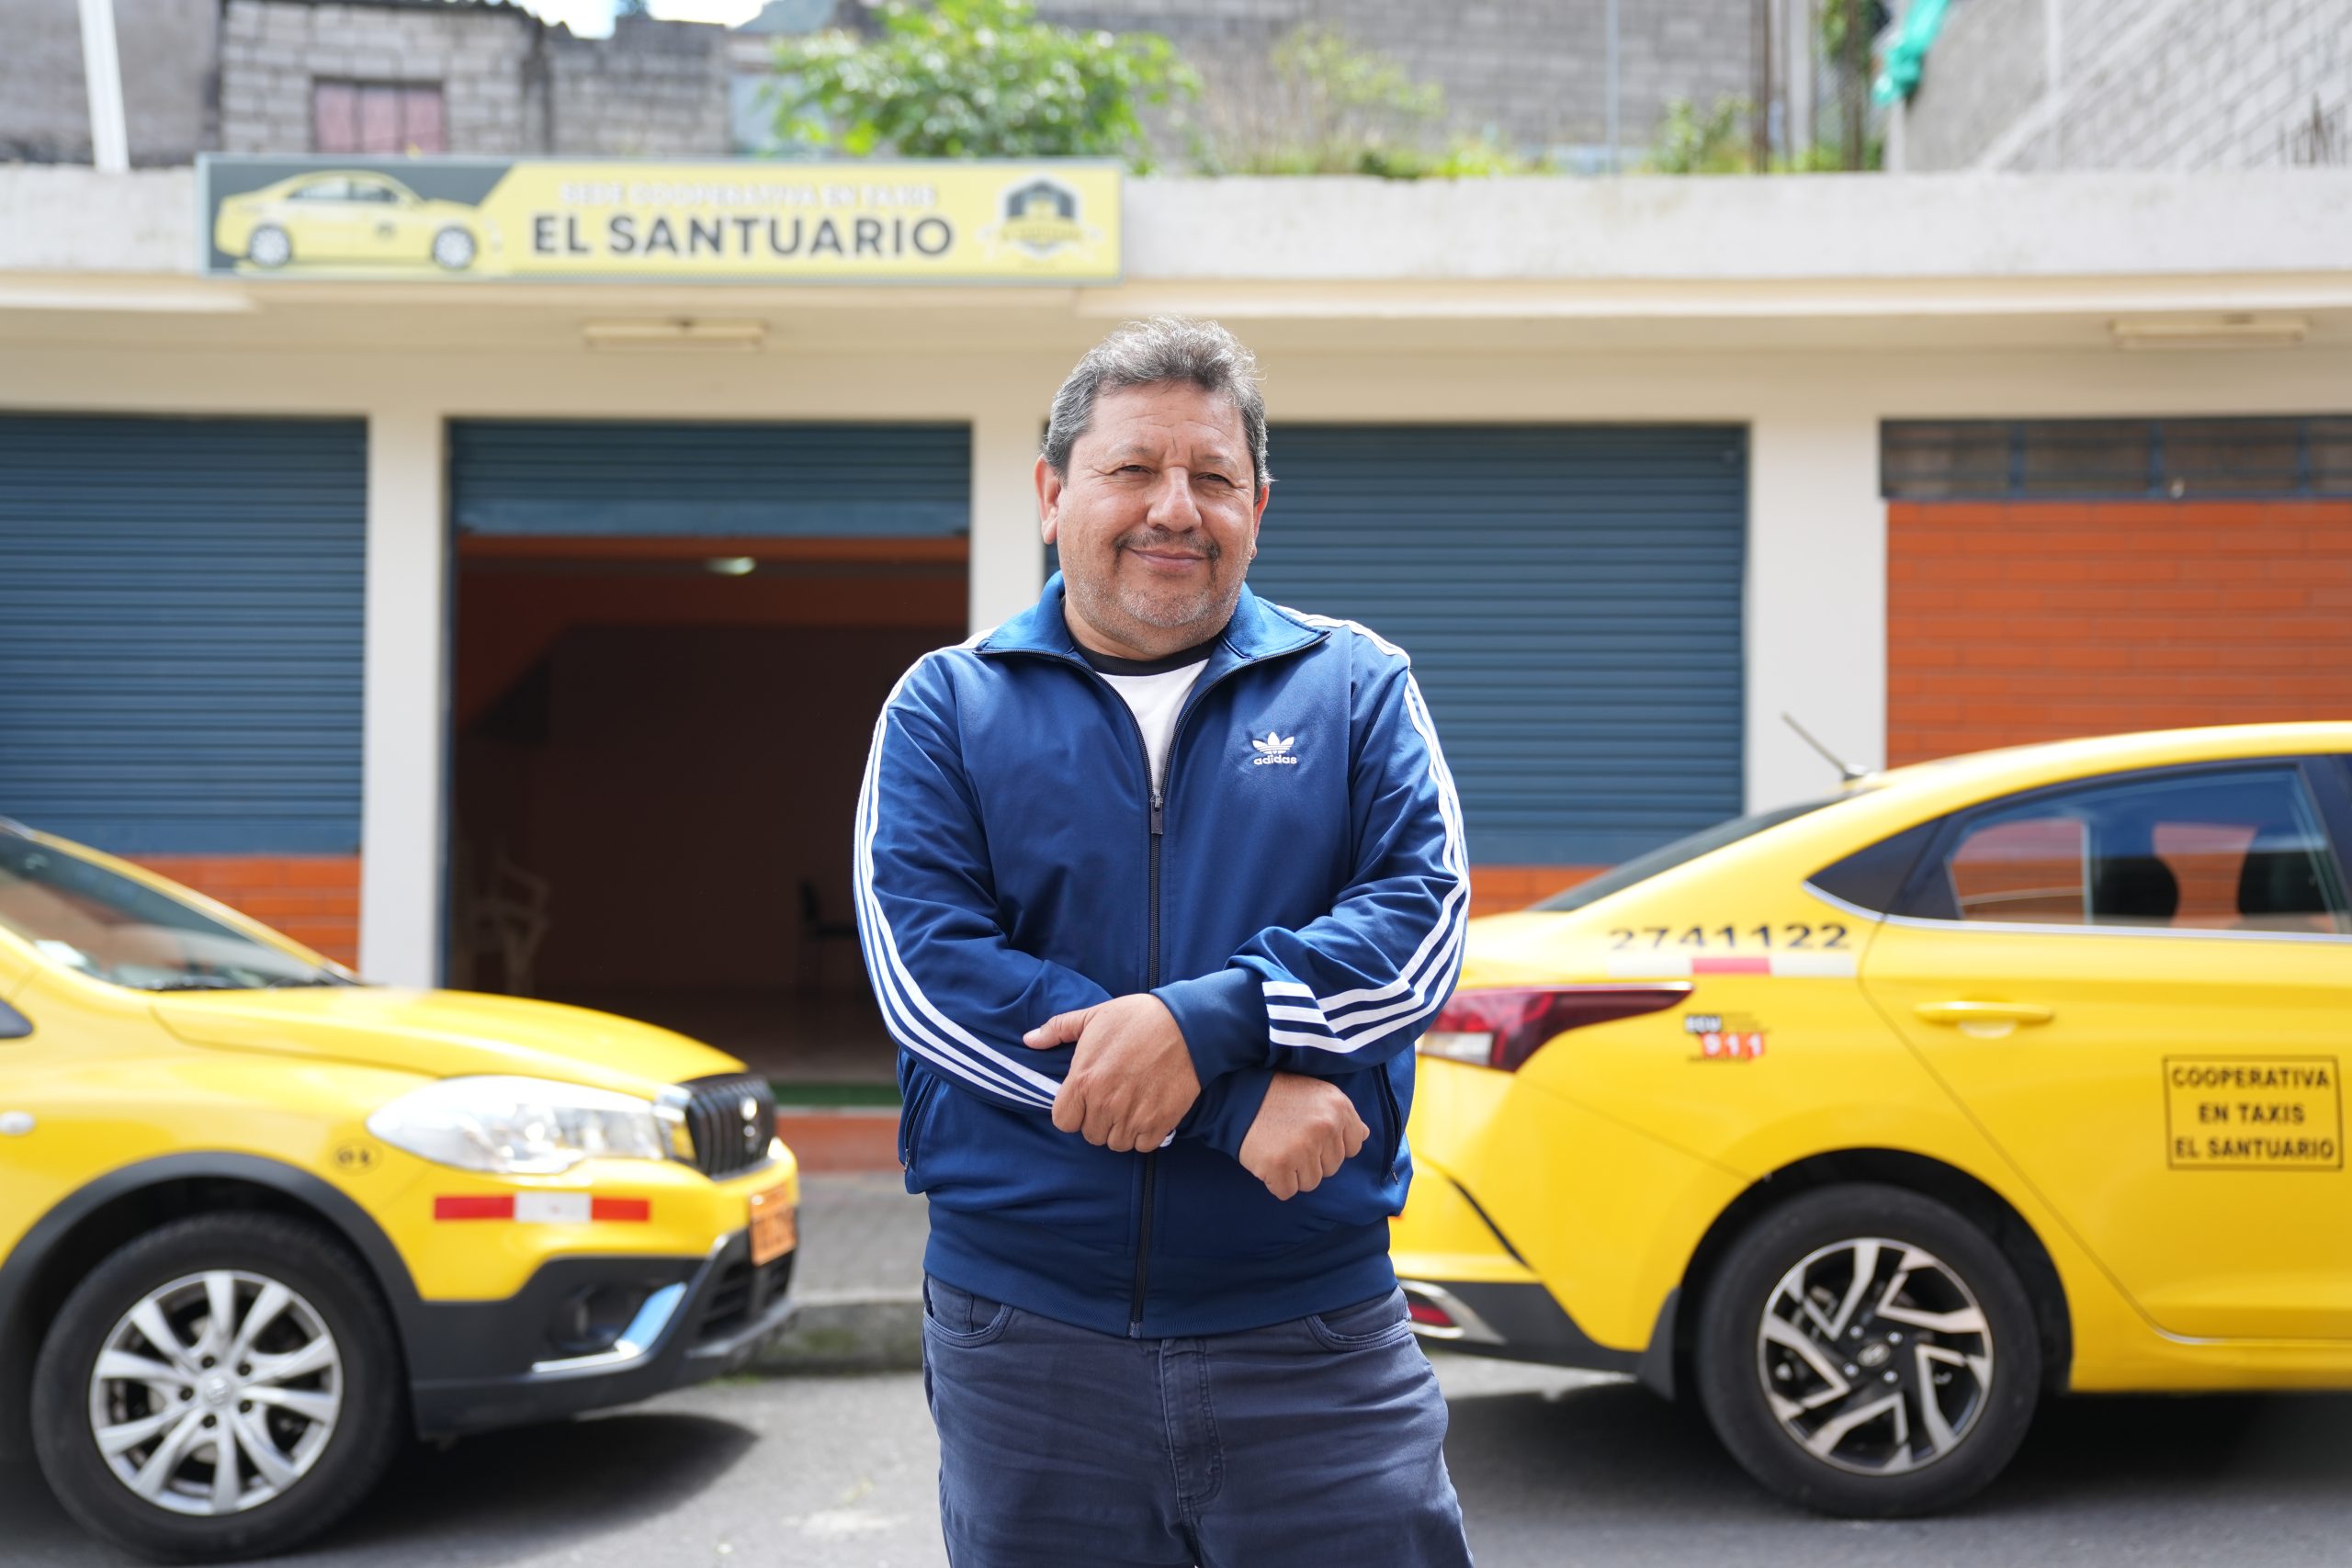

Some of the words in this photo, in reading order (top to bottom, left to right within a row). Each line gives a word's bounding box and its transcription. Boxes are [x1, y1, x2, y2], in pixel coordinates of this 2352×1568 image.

[533, 215, 590, 254] EL
[608, 214, 953, 256] SANTUARIO
[1253, 755, 1297, 765] adidas
[1609, 922, 1849, 950] 2741122
[1703, 1032, 1762, 1056] 911
[2171, 1067, 2330, 1089] COOPERATIVA
[2199, 1103, 2229, 1123] EN
[2237, 1103, 2305, 1124] TAXIS
[2175, 1138, 2199, 1158] EL
[2208, 1138, 2334, 1159] SANTUARIO
